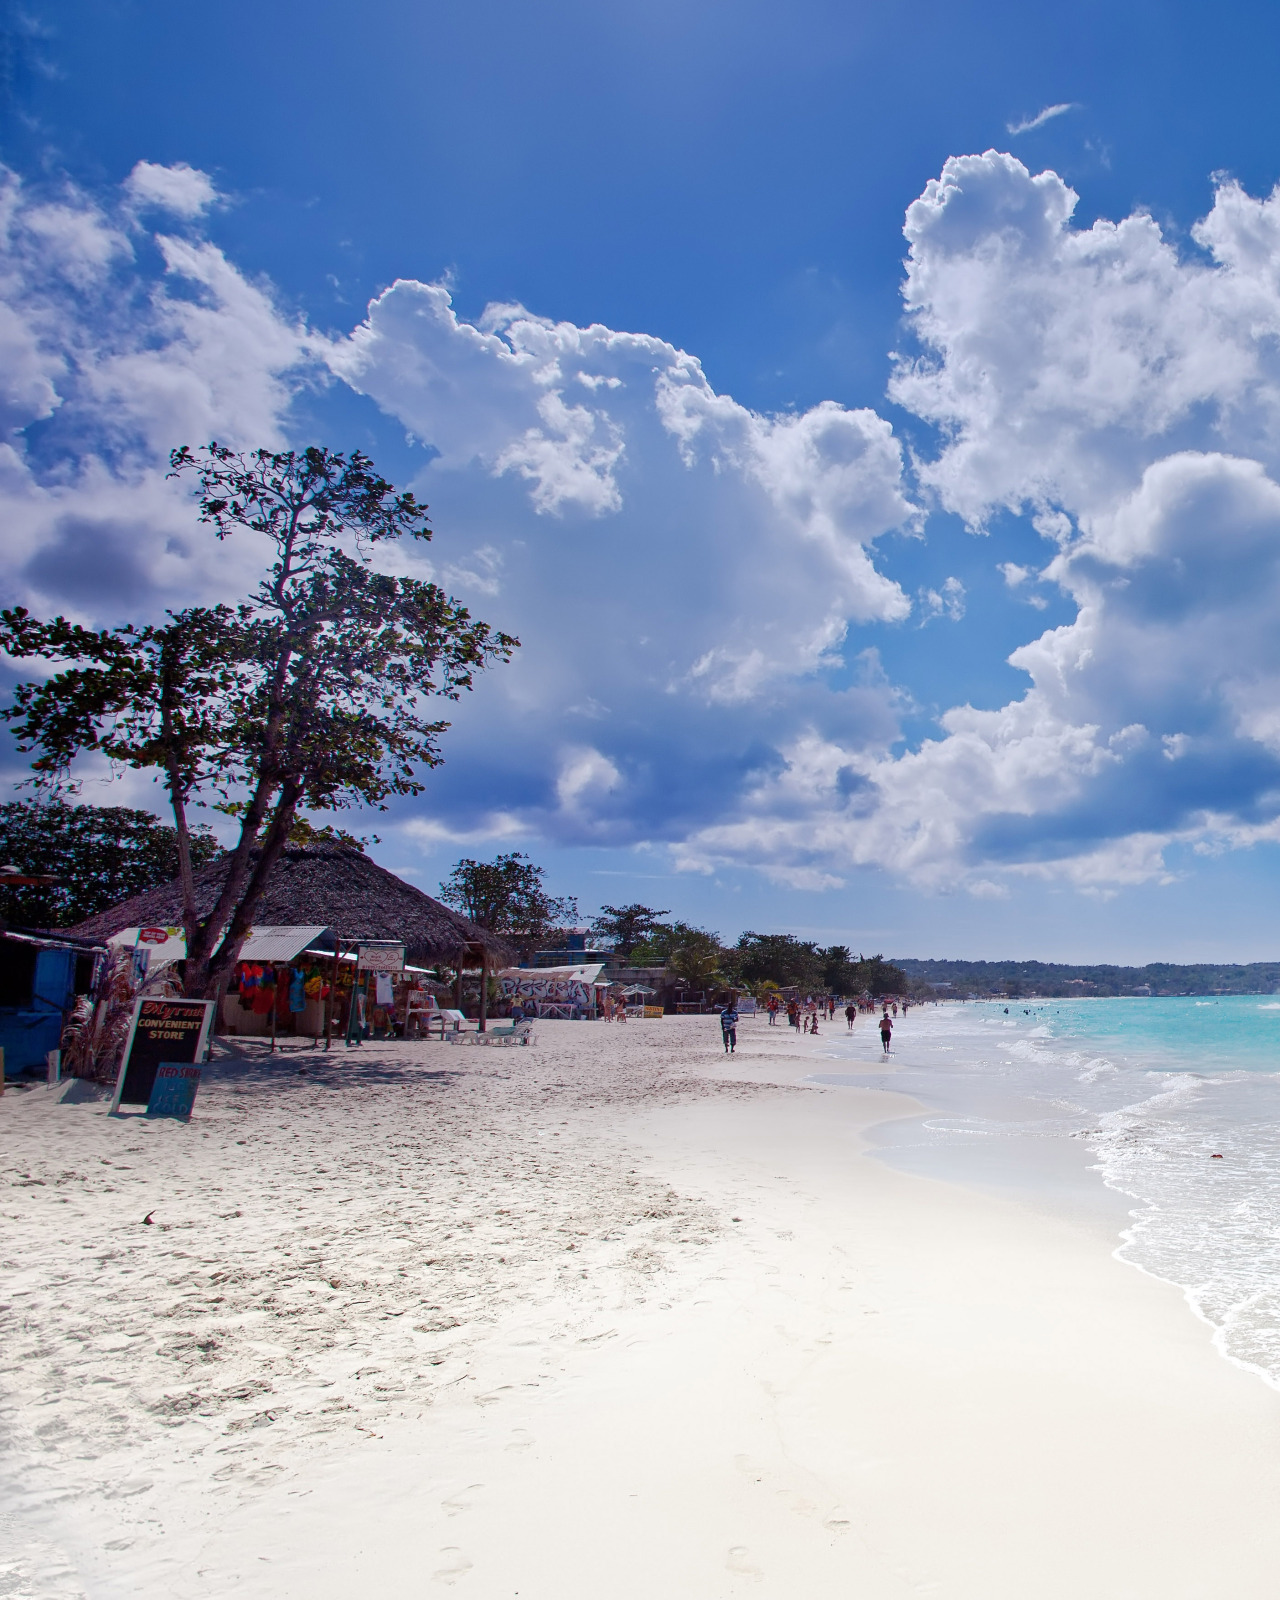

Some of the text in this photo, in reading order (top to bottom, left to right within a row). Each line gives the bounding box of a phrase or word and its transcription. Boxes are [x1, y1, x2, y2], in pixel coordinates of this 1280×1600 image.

[138, 1019, 201, 1030] CONVENIENT
[149, 1031, 184, 1039] STORE
[159, 1067, 178, 1078] RED
